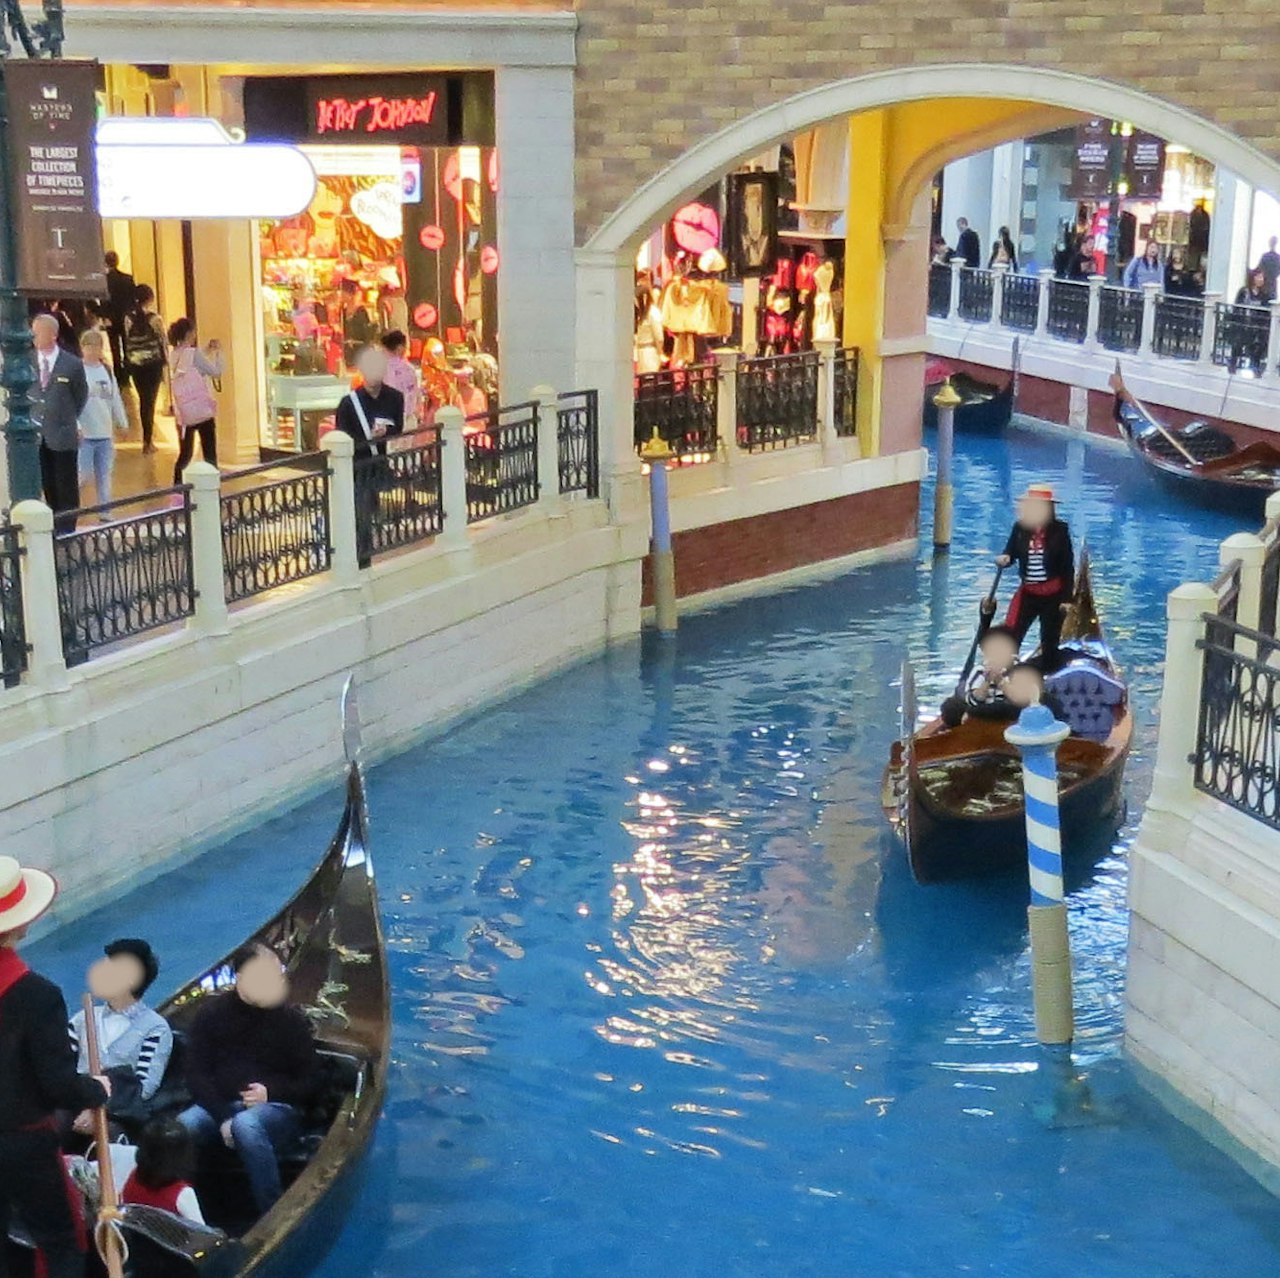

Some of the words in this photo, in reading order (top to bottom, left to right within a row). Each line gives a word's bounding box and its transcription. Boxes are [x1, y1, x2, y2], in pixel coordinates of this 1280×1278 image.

[29, 146, 44, 158] THE
[45, 146, 78, 159] LARGEST
[30, 161, 77, 173] COLLECTION
[26, 174, 37, 187] OF
[38, 175, 84, 187] TIMEPIECES
